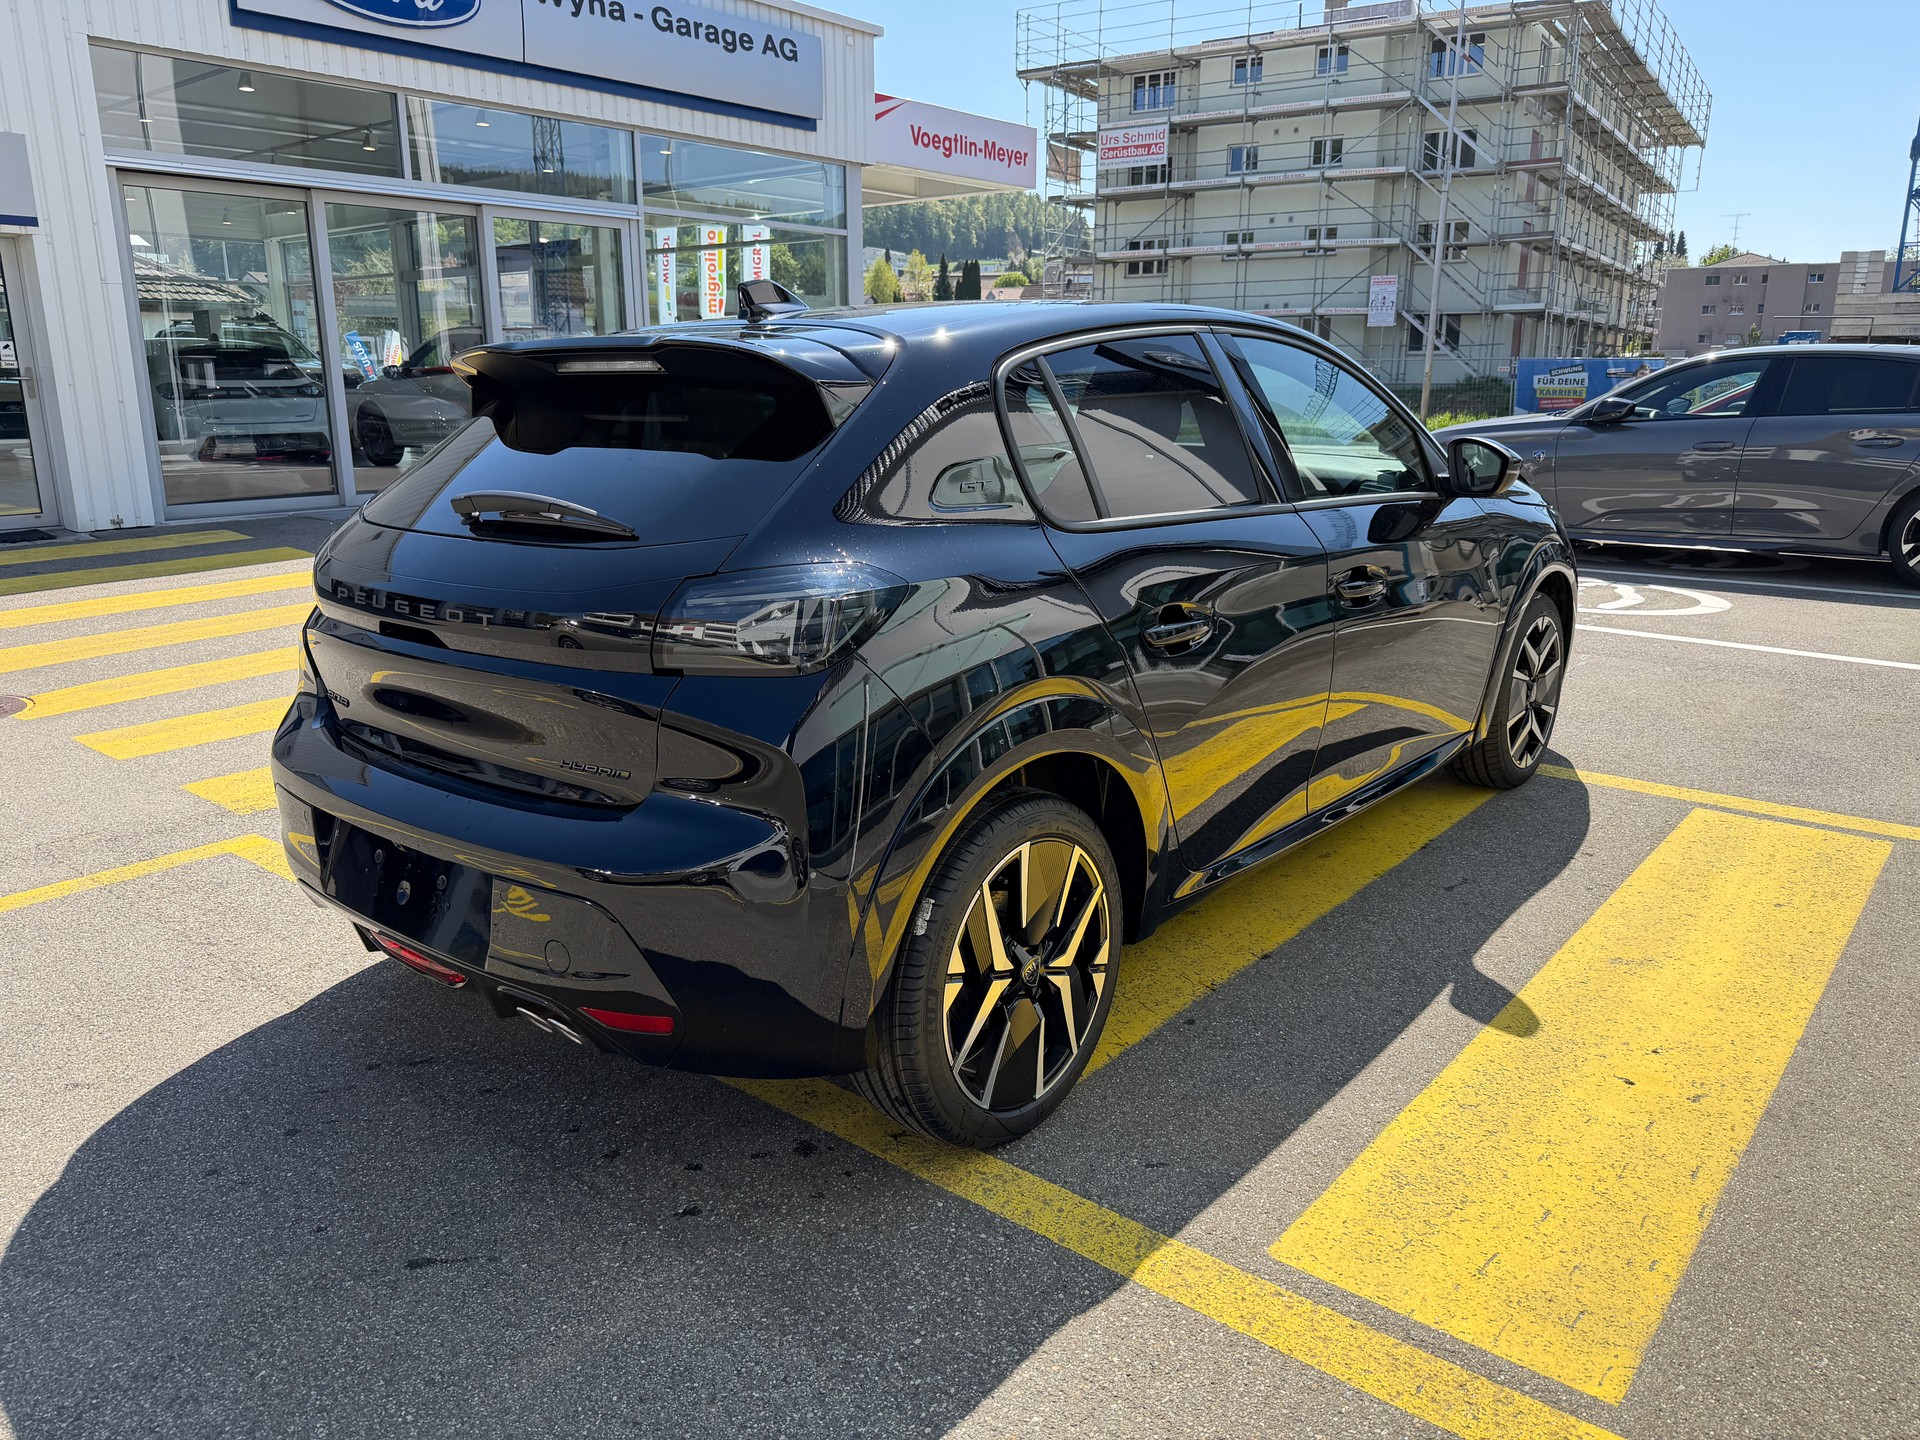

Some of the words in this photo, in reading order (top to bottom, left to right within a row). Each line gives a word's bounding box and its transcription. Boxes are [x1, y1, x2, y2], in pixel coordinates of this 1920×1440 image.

[539, 0, 626, 22] yna
[651, 6, 754, 54] Garage
[761, 34, 799, 62] AG
[910, 124, 1029, 168] Voegtlin-Meyer
[1100, 134, 1119, 146] Urs
[1122, 129, 1166, 143] Schmid
[1101, 146, 1148, 159] Gerüstbau
[1149, 143, 1164, 154] AG
[752, 231, 762, 281] MIGRL
[704, 230, 721, 314] migrolio
[1537, 376, 1555, 386] FÜR
[1557, 378, 1586, 386] DEINE
[1551, 365, 1583, 376] SCHWUNG
[1538, 389, 1584, 397] KARRIERE
[960, 480, 993, 494] GT
[337, 586, 494, 627] PEUGEOT
[560, 759, 632, 780] HYBRID
[930, 943, 945, 980] 205/45
